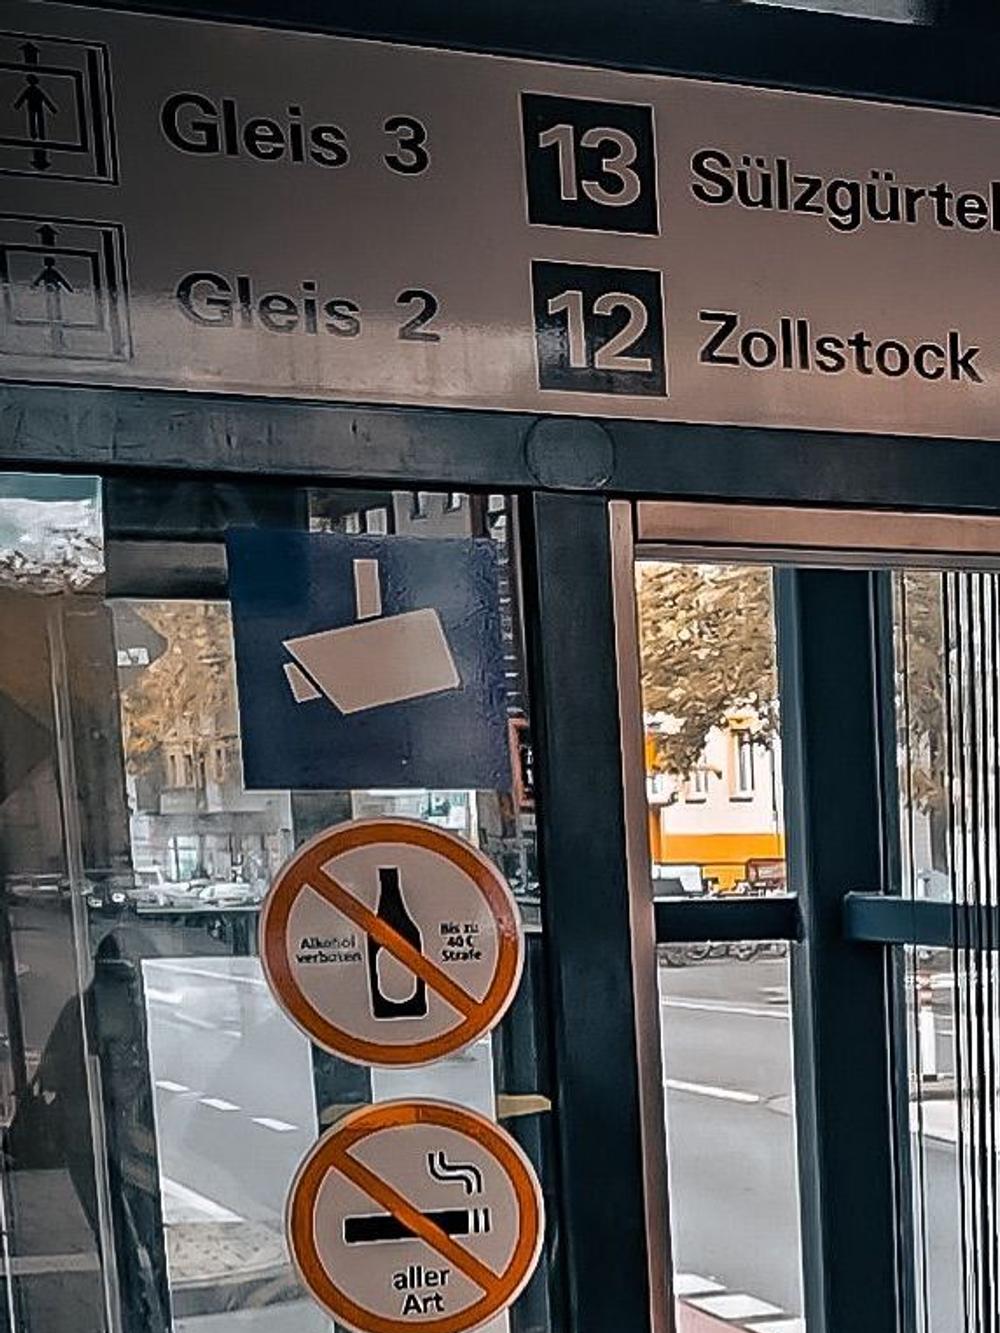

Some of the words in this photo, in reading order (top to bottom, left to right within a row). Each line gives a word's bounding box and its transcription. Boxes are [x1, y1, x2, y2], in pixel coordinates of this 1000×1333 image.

[161, 92, 349, 168] Gleis
[383, 117, 430, 175] 3
[538, 124, 641, 207] 13
[176, 272, 362, 338] Gleis
[396, 289, 441, 343] 2
[547, 290, 653, 373] 12
[700, 310, 983, 385] Zollstock
[296, 950, 362, 963] verboten
[442, 948, 482, 962] Strafe
[392, 1267, 450, 1290] aller
[401, 1291, 446, 1316] Art
